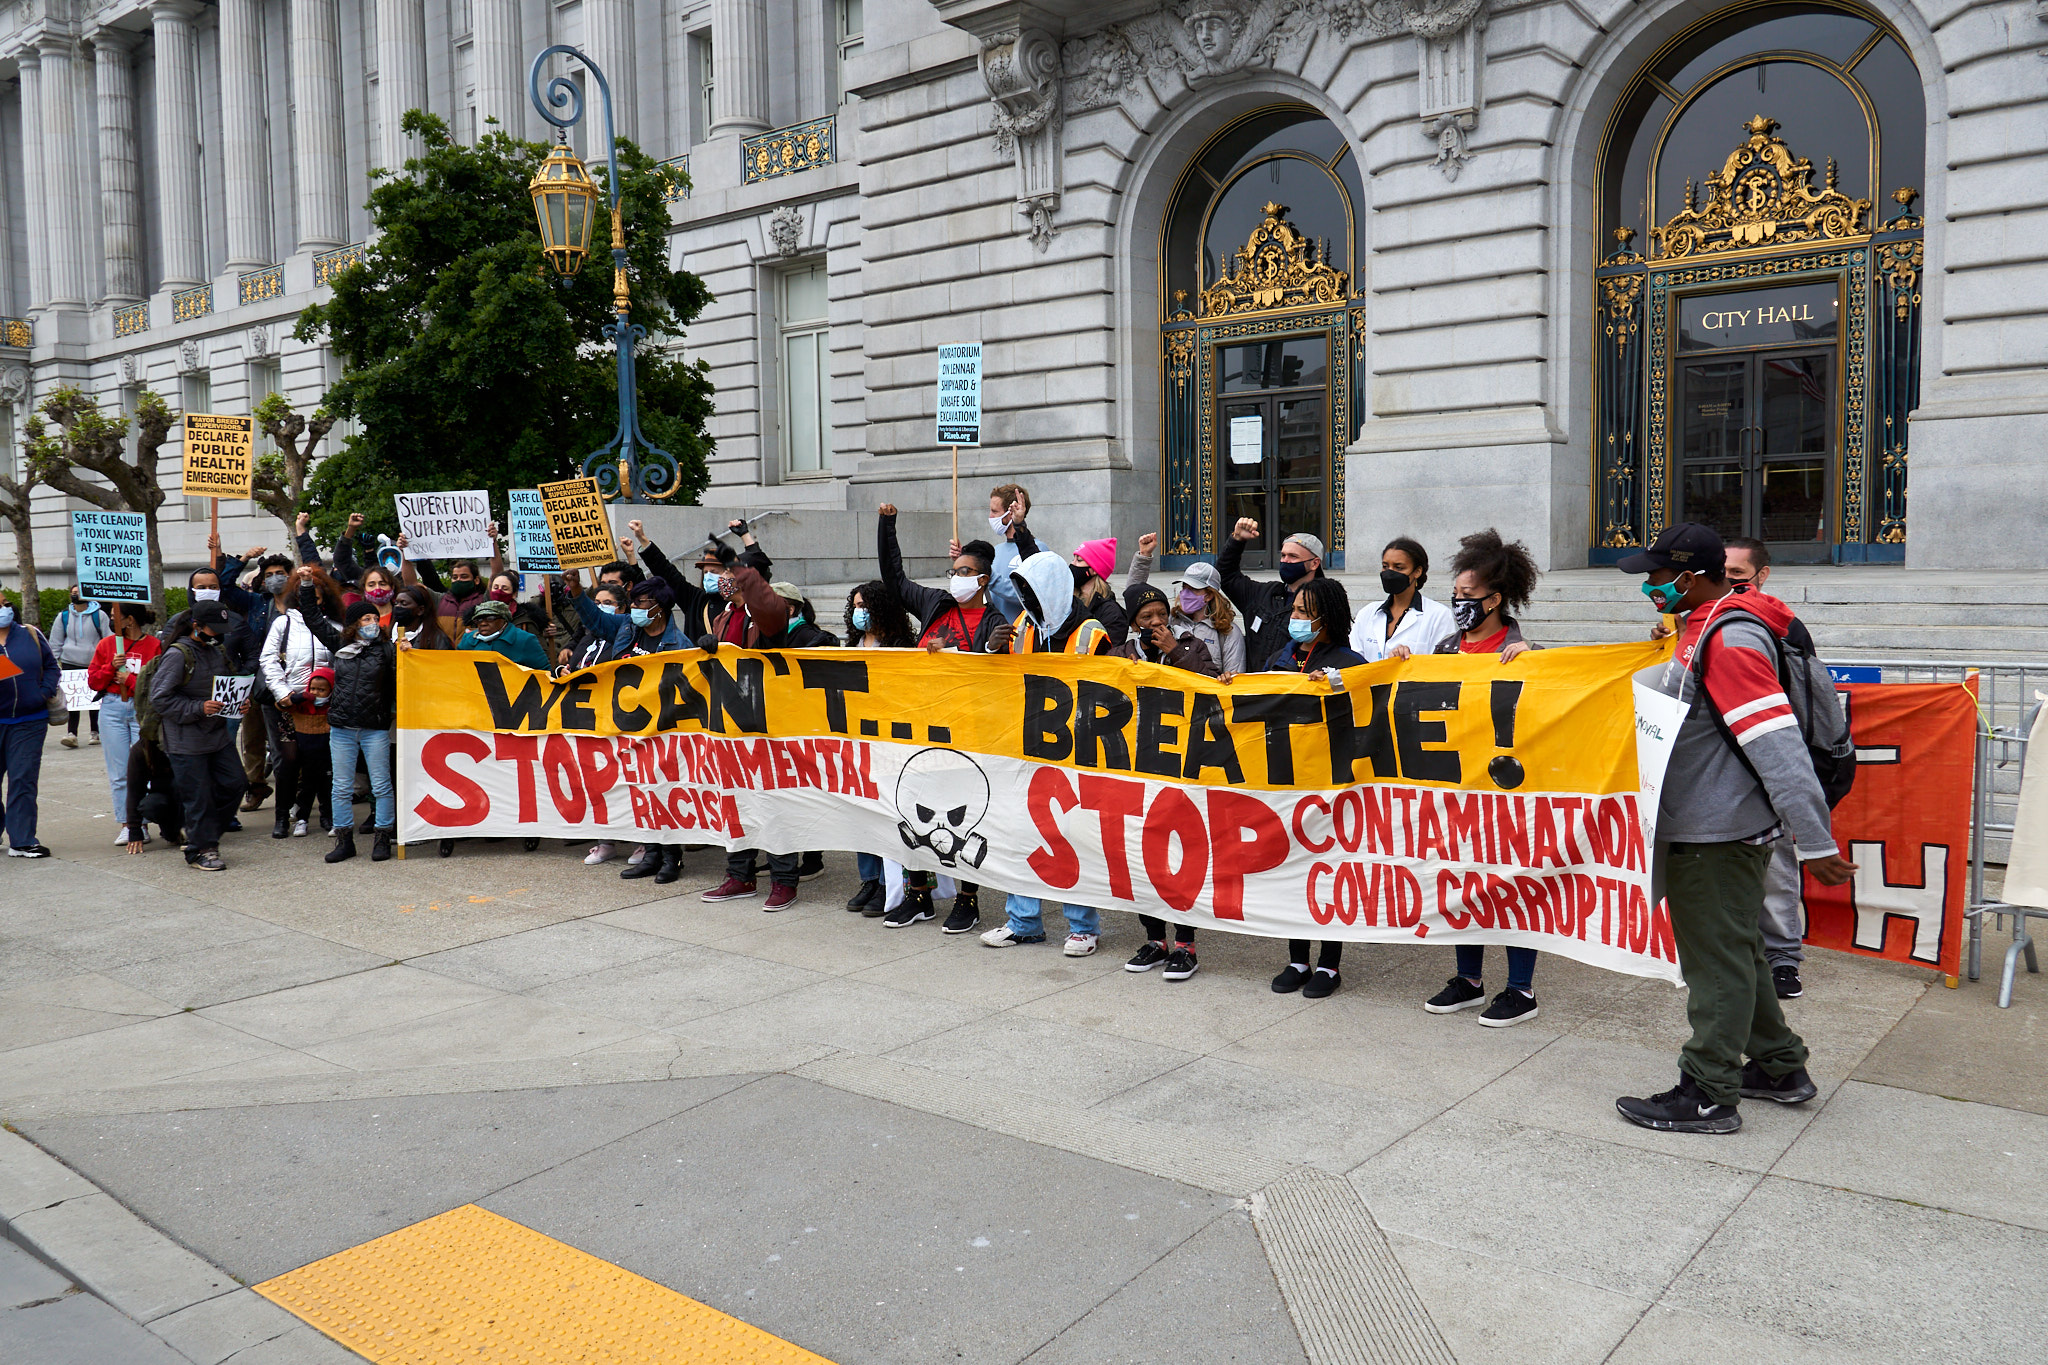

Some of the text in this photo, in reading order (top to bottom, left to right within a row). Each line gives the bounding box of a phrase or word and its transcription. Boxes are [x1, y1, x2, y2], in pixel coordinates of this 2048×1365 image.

[1702, 304, 1814, 330] CITY HALL
[940, 346, 980, 359] MORATORIUM
[950, 363, 976, 375] LENNAR
[941, 379, 976, 391] SHIPYARD &
[941, 396, 976, 407] UNSAFE SOIL
[194, 422, 244, 431] SUPERVISORS:
[188, 430, 249, 444] DECLARE A
[191, 443, 245, 457] PUBLIC
[190, 456, 245, 471] HEALTH
[186, 470, 248, 486] EMERGENCY
[185, 486, 248, 495] ANSWERCOALITION.ORG
[544, 484, 565, 493] MAYOR
[564, 482, 585, 491] BREED
[548, 488, 590, 499] SUPERVISORS:
[511, 493, 530, 503] SAFE
[545, 498, 590, 513] DECLARE
[592, 495, 599, 506] A
[399, 495, 485, 518] SUPERFUND
[519, 506, 540, 516] TOXIC
[75, 513, 143, 527] SAFE CLEANUP
[552, 509, 599, 525] PUBLIC
[403, 517, 488, 540] SUPERFRAUD!
[517, 520, 529, 530] AT
[555, 523, 603, 541] HEALTH
[83, 528, 112, 540] TOXIC
[113, 530, 144, 542] WASTE
[520, 533, 551, 542] & TREAS
[80, 542, 143, 556] AT SHIPYARD
[408, 541, 435, 555] TOXIC
[464, 536, 489, 552] NOW
[529, 545, 556, 556] ISLAND
[556, 538, 609, 556] EMERGENCY
[84, 556, 142, 569] & TREASURE
[561, 553, 614, 565] ANSWERCOALITION.ORG
[95, 570, 133, 583] ISLAND!
[92, 588, 138, 599] PSLweb.org
[215, 677, 236, 692] WE
[474, 660, 597, 731] WE
[413, 732, 619, 828] STOP
[617, 734, 879, 801] ENVIRONMENTAL
[1026, 766, 1289, 921] STOP
[1291, 786, 1646, 874] CONTAMINATION
[1306, 861, 1429, 939] COVID,
[1437, 867, 1677, 965] CORRUPTION
